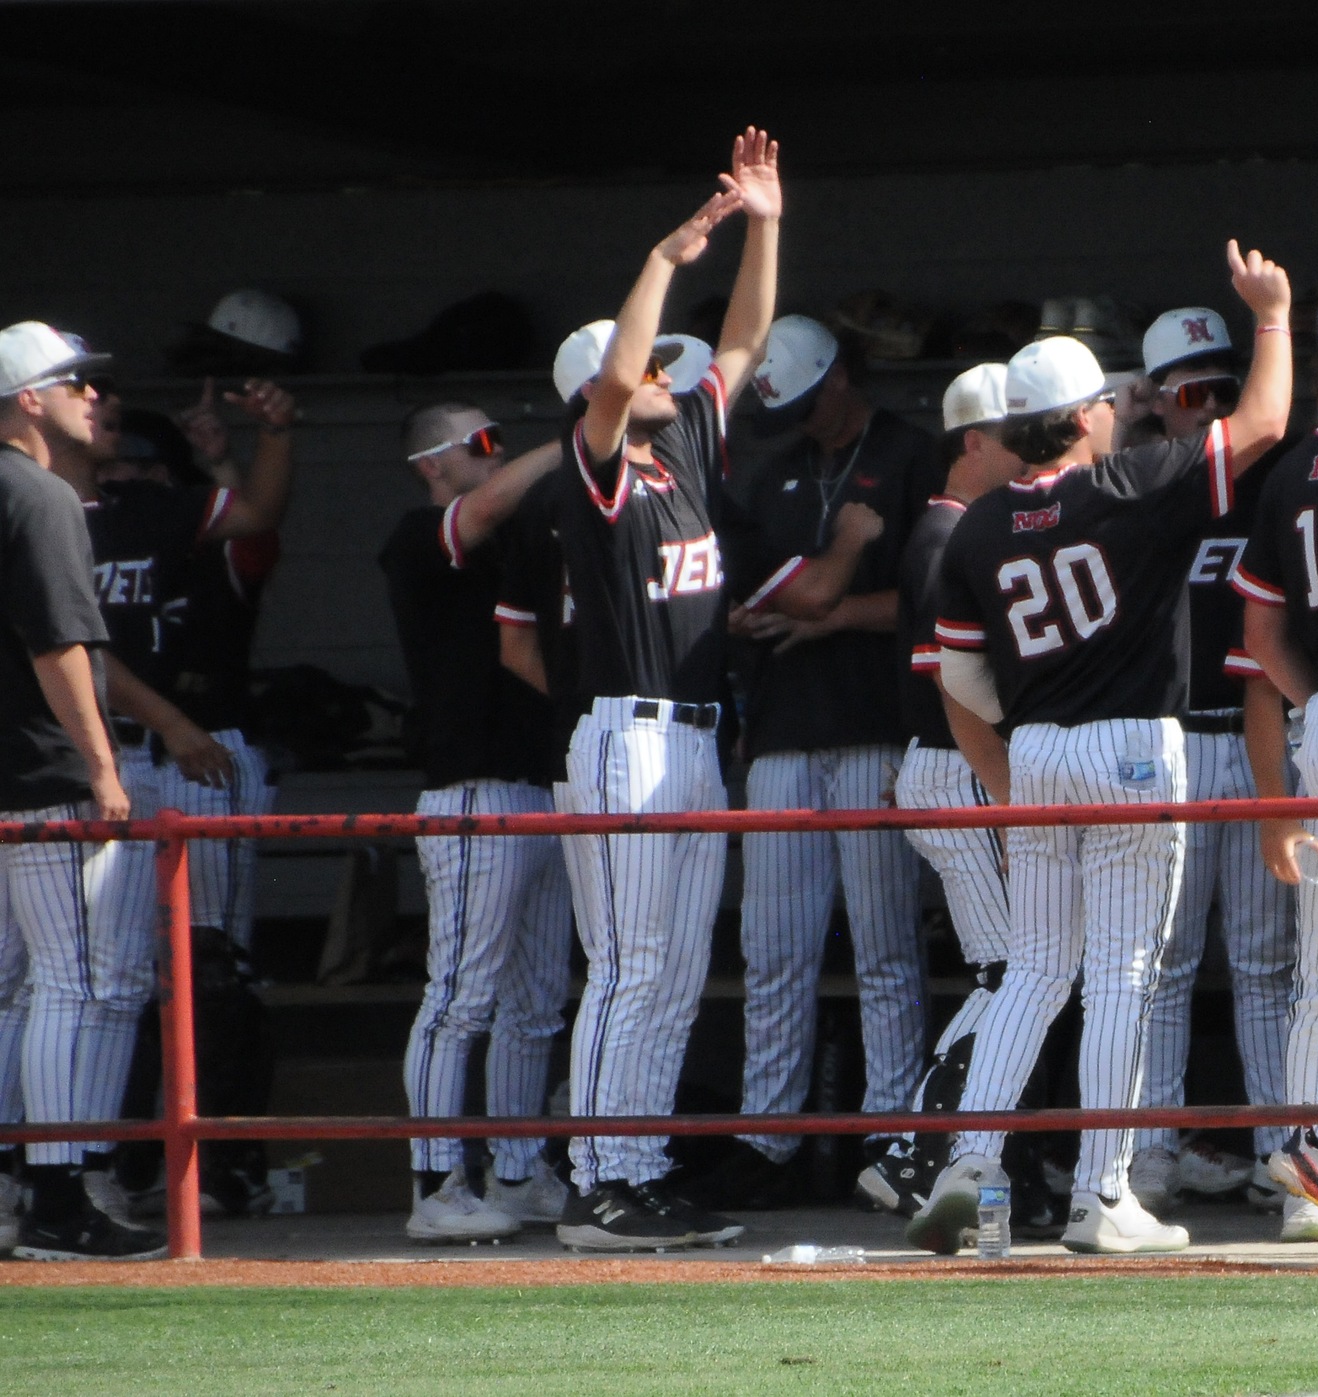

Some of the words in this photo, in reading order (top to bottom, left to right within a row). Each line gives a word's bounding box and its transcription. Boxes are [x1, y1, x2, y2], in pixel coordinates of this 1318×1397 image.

[1181, 317, 1215, 345] N
[1187, 537, 1249, 582] ET
[997, 543, 1118, 659] 20
